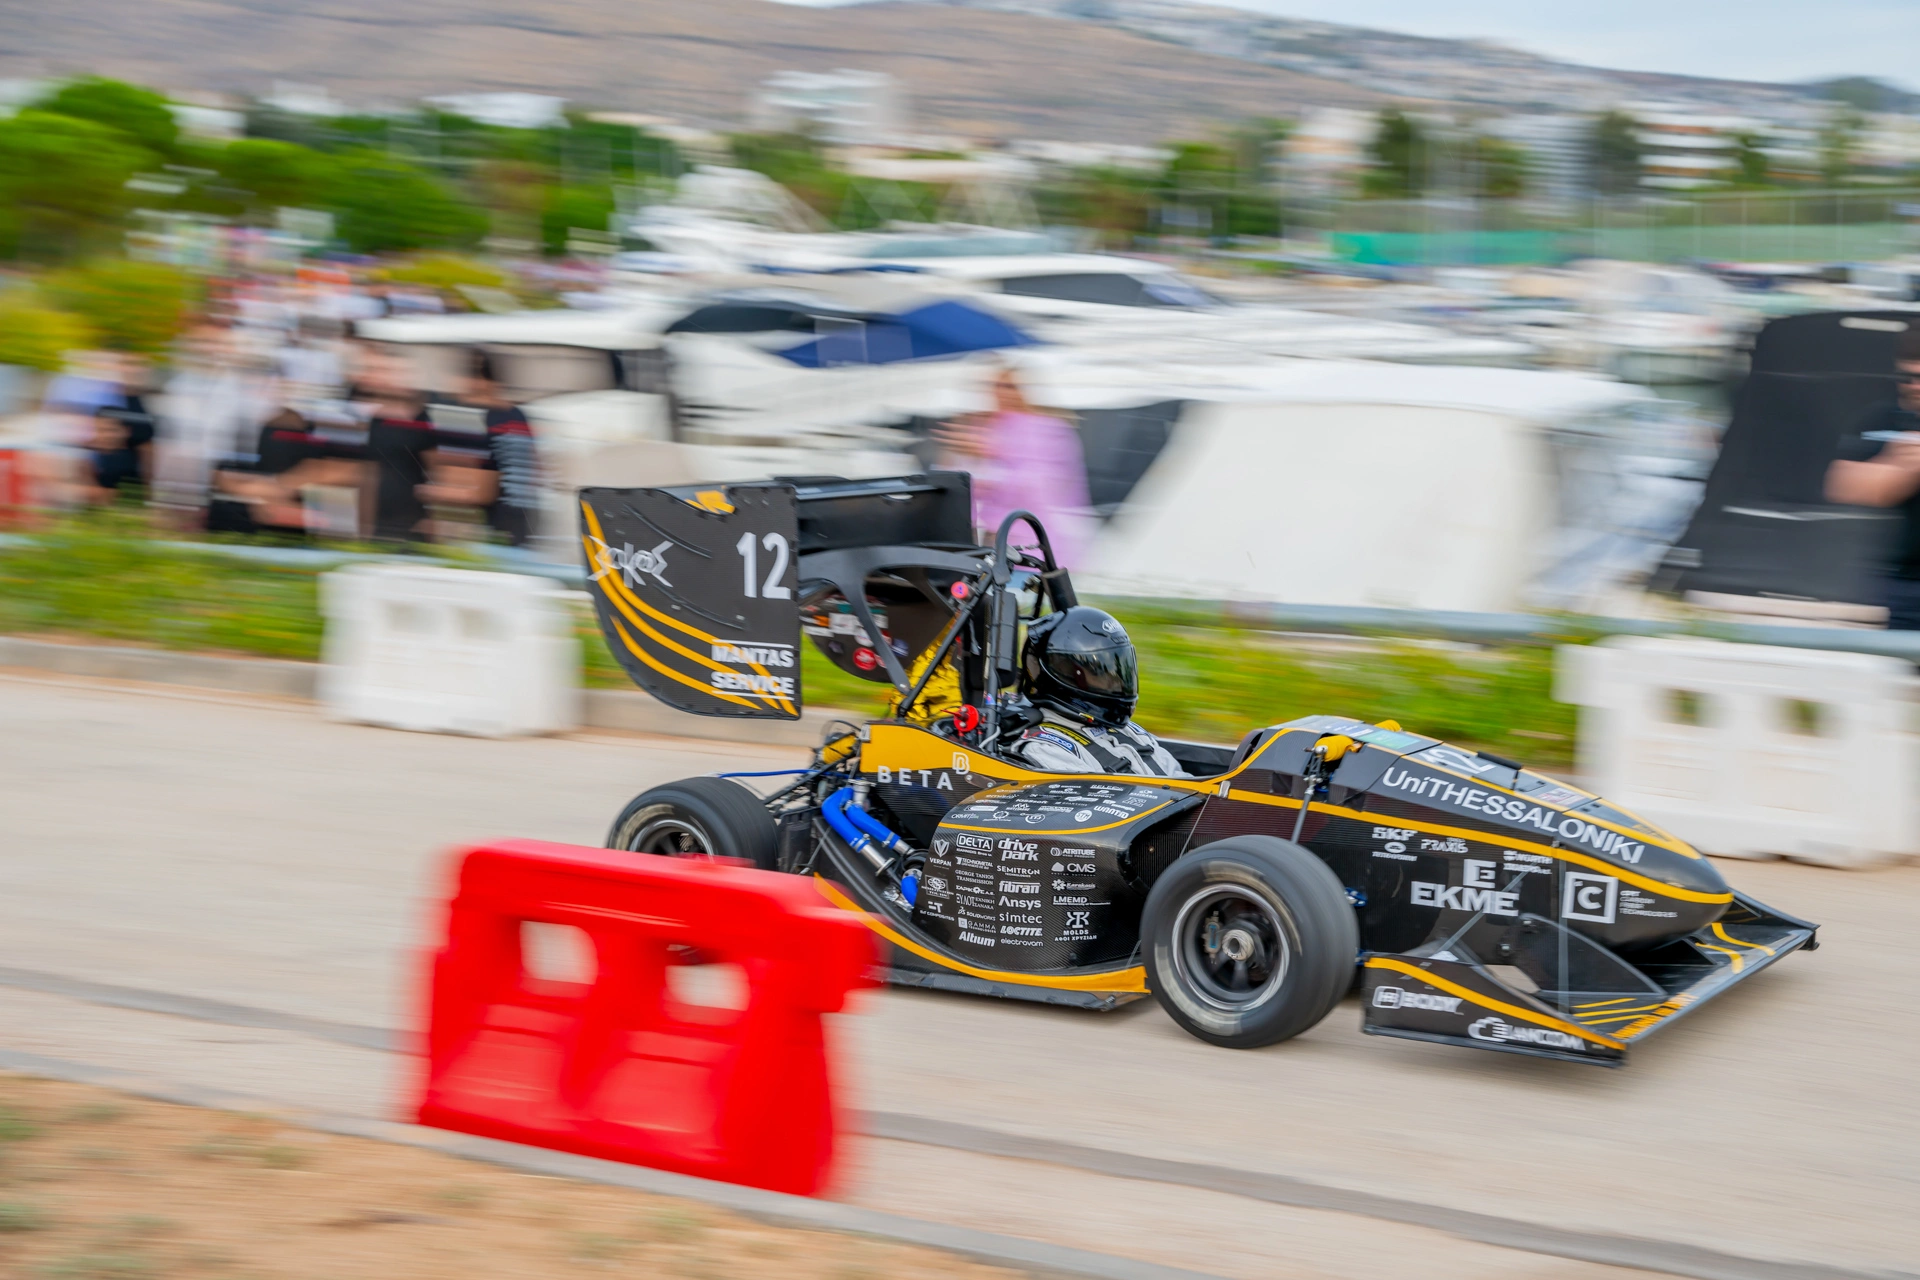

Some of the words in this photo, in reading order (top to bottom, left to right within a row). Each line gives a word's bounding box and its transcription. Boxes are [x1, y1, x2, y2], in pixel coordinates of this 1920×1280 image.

[736, 532, 791, 600] 12
[711, 644, 794, 667] MANTAS
[711, 671, 794, 694] SERVICE
[877, 765, 954, 791] BETA
[1382, 767, 1645, 865] UniTHESSALONIKI
[1372, 827, 1417, 841] SKF
[959, 835, 991, 850] DELTA
[998, 838, 1038, 852] drive
[1421, 839, 1468, 853] PRAXIS
[1001, 849, 1039, 861] park
[1062, 848, 1096, 856] ATRITUBE
[930, 857, 952, 867] VERPAN
[1067, 863, 1096, 873] CMS
[955, 869, 974, 878] GEORGE
[997, 865, 1040, 875] SEMITRON
[956, 875, 994, 885] TRANSMISSION
[999, 880, 1041, 894] fibran
[998, 895, 1041, 911] Ansys
[1053, 896, 1088, 904] LMEMD
[1411, 881, 1519, 917] EKME
[966, 911, 996, 921] SOLIDWORKS
[999, 912, 1043, 924] simtec
[968, 920, 996, 930] GAMMA
[1000, 925, 1043, 937] LOCTITE
[959, 931, 996, 947] Altium
[1401, 993, 1464, 1013] BODY
